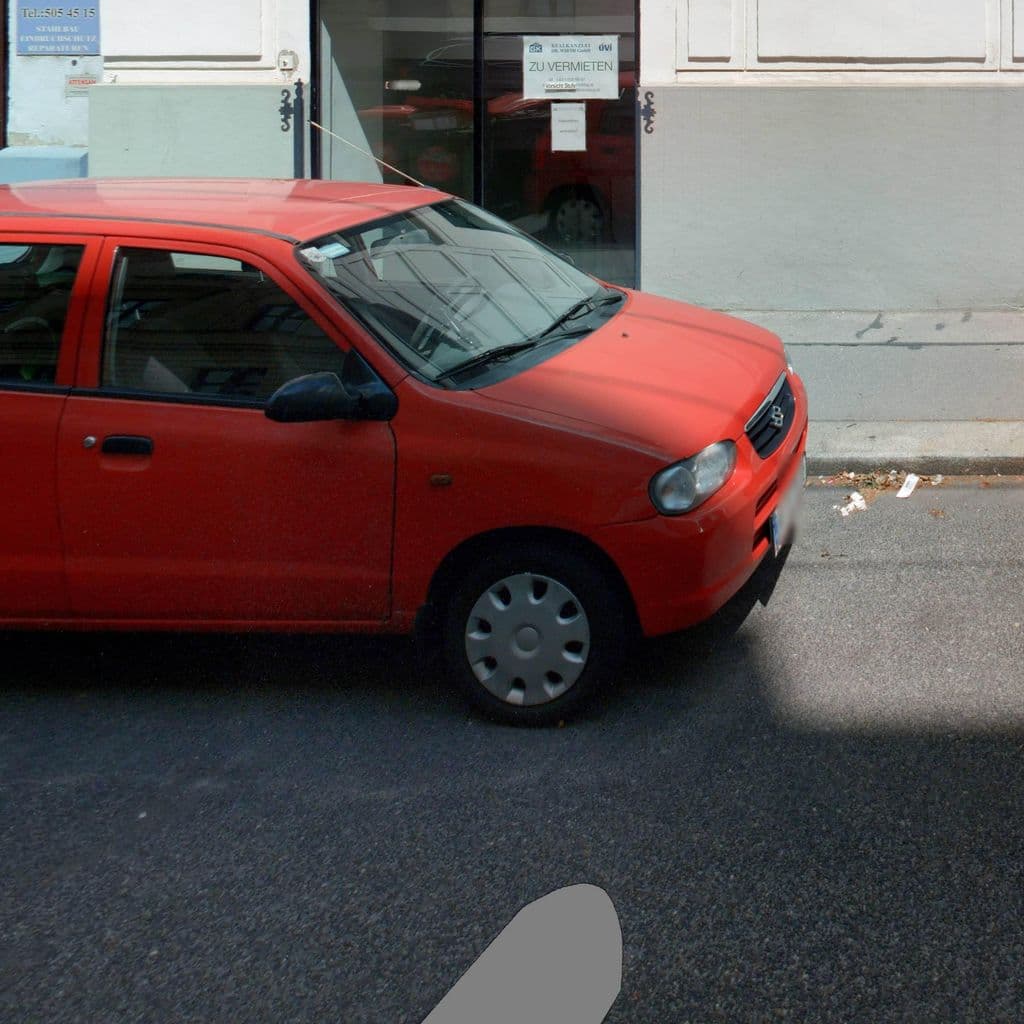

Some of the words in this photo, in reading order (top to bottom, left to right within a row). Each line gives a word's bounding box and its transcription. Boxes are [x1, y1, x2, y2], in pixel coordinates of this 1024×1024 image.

[66, 8, 79, 18] 45
[83, 8, 96, 18] 15
[529, 61, 545, 72] ZU
[547, 61, 613, 72] VERMIETEN
